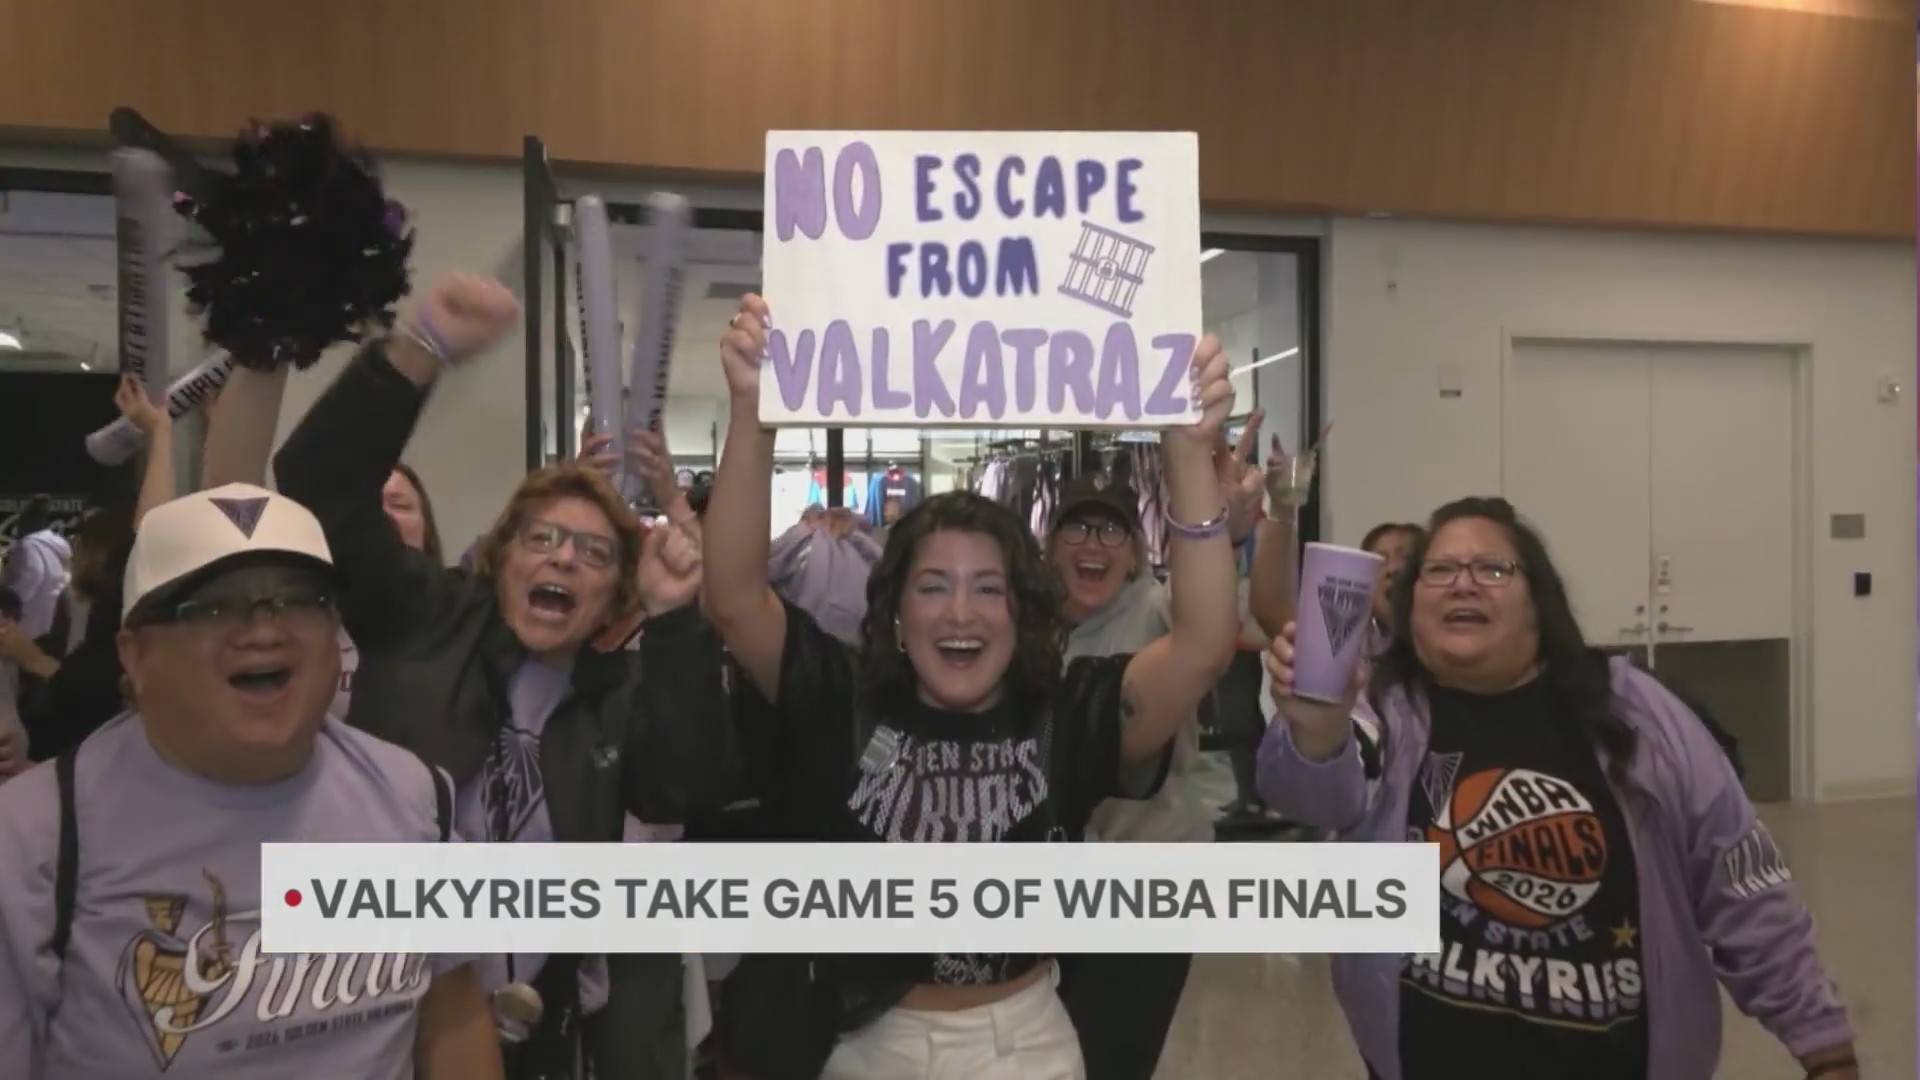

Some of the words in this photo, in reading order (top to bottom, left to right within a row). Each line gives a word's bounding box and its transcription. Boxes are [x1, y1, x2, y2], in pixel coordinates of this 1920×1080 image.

[775, 141, 882, 242] NO
[914, 153, 1145, 224] ESCAPE
[886, 235, 1039, 298] FROM
[769, 319, 1196, 421] VALKATRAZ
[1465, 776, 1580, 841] WNBA
[1476, 817, 1604, 876] FINALS
[1493, 872, 1578, 911] 2026
[1483, 913, 1595, 949] STATE
[1402, 938, 1642, 1006] ALKYRIES
